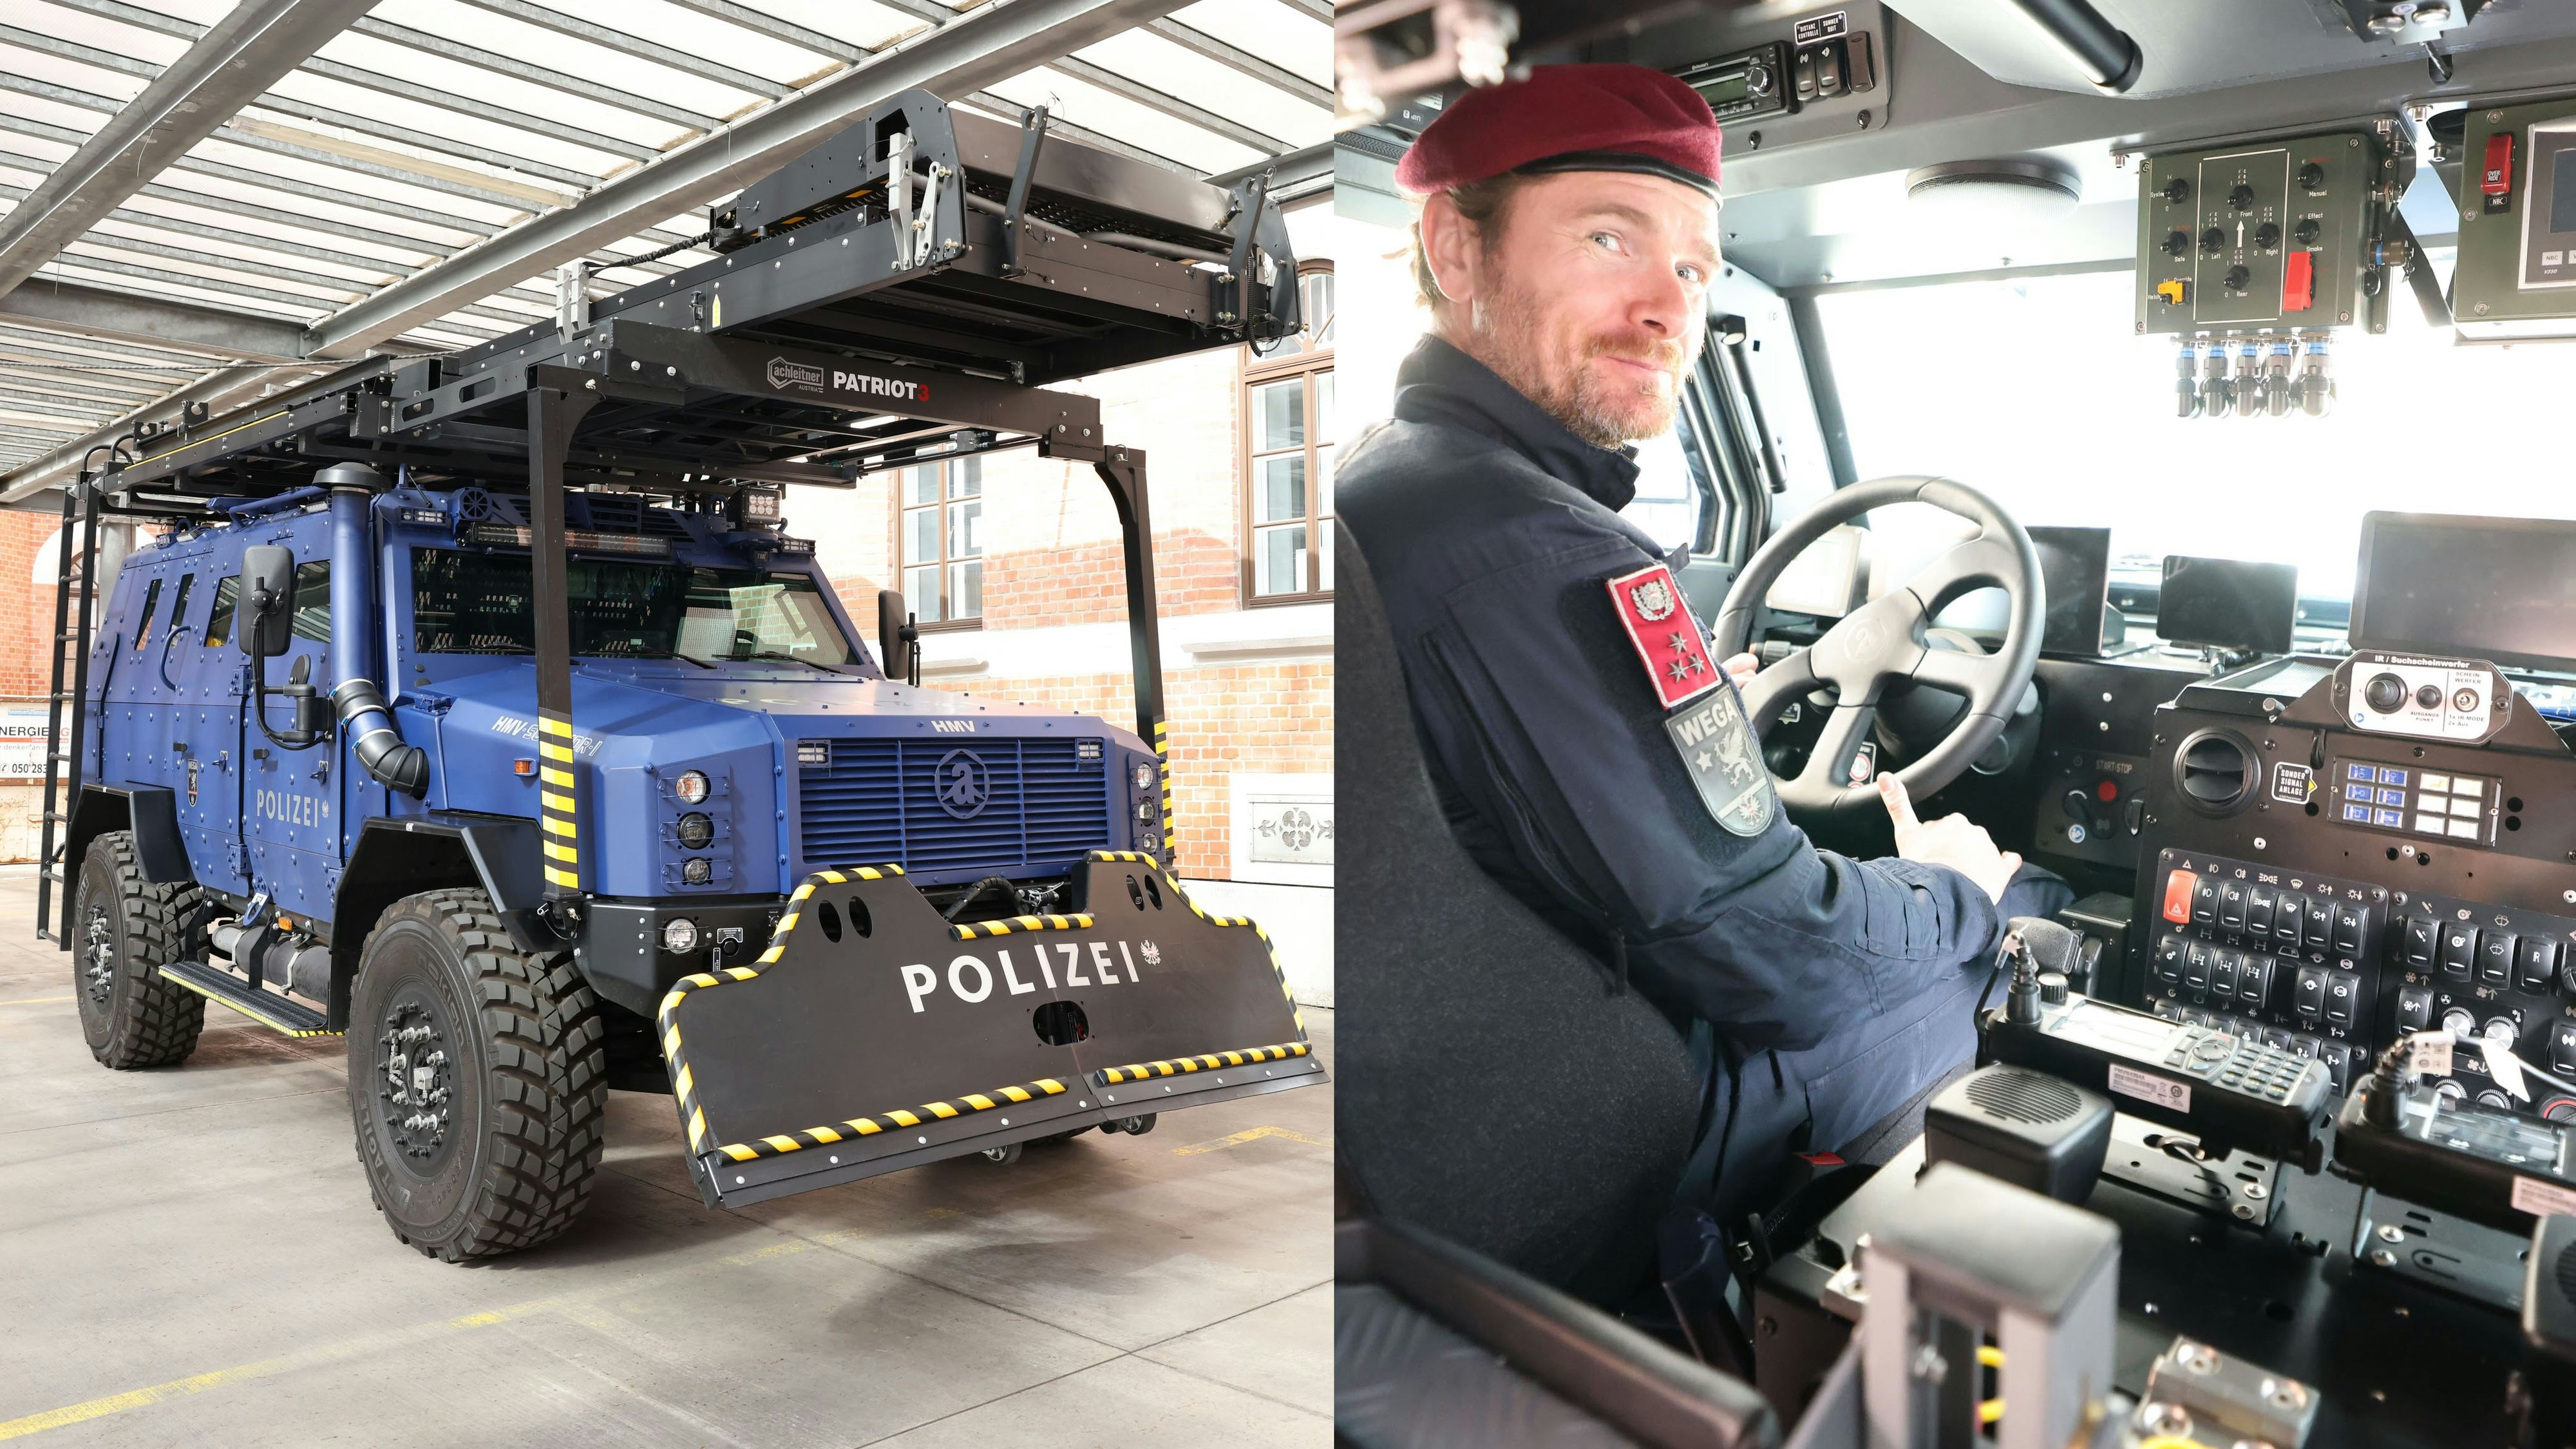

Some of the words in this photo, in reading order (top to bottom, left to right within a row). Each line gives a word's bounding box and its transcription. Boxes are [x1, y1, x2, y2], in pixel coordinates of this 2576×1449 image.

[1798, 29, 1819, 39] KONTROLLE
[774, 365, 820, 383] achleitner
[799, 384, 819, 393] AUSTRIA
[2391, 656, 2470, 668] Suchscheinwerfer
[931, 720, 975, 732] HMV
[1676, 697, 1738, 747] WEGA
[12, 763, 28, 773] 050
[2280, 770, 2306, 780] SONDER
[2280, 777, 2303, 788] SIGNAL
[2279, 785, 2303, 796] ANLAGE
[256, 789, 318, 828] POLIZEI
[900, 941, 1140, 1013] POLIZEI
